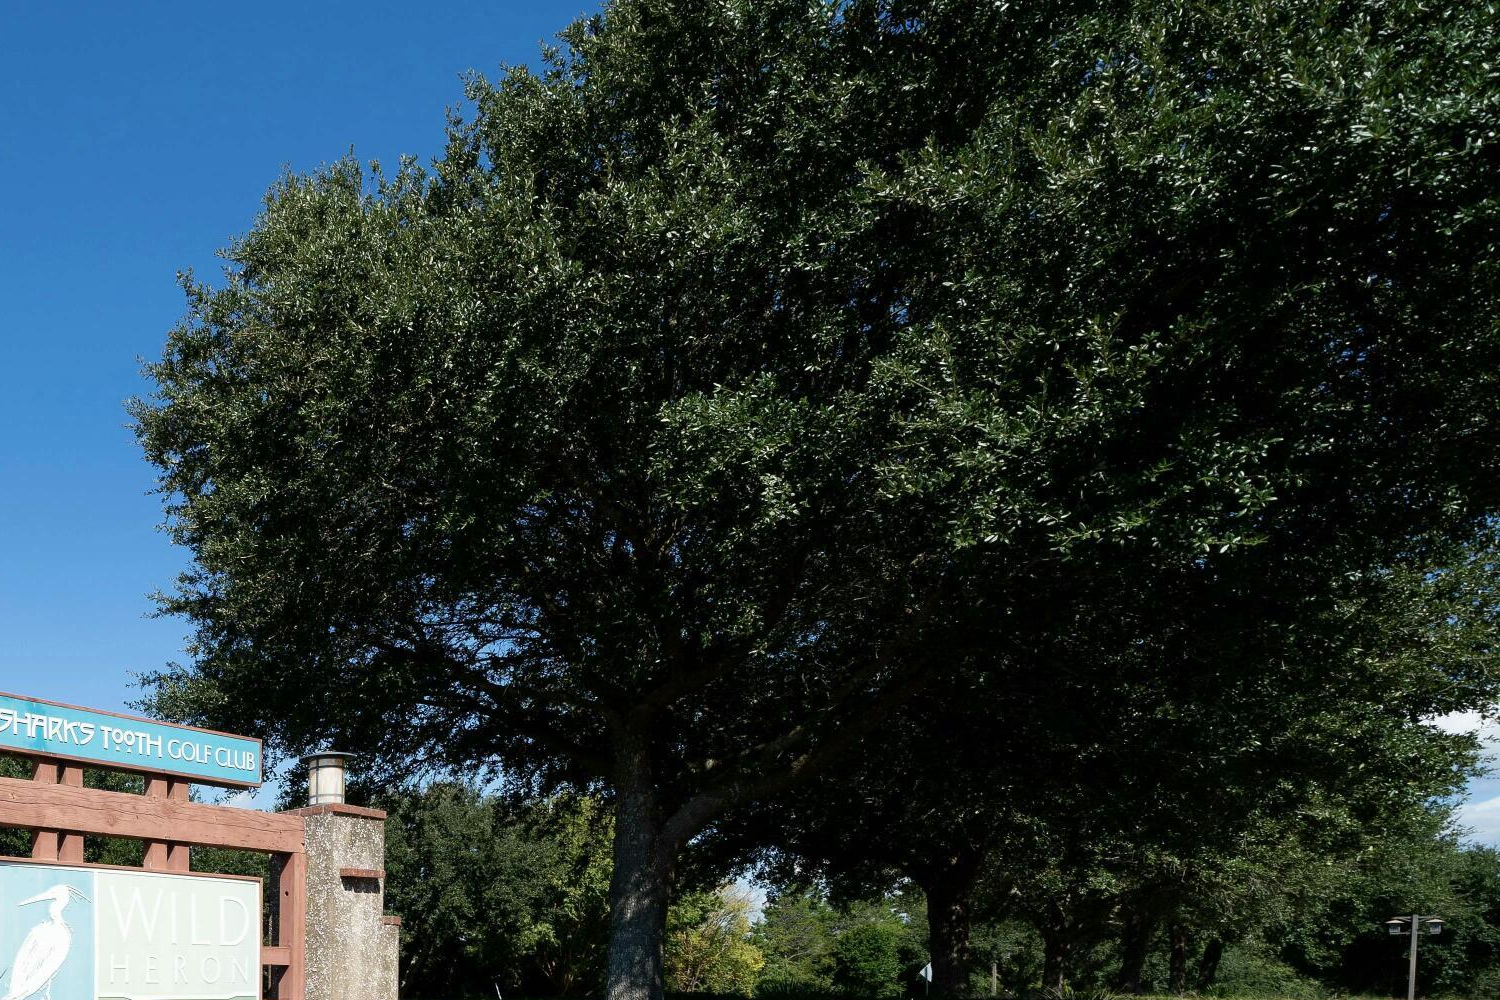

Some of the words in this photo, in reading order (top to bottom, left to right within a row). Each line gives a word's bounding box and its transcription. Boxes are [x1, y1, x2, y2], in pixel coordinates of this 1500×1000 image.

[100, 725, 162, 758] TOOTH
[167, 739, 212, 764] GOLF
[215, 747, 255, 771] CLUB
[109, 886, 250, 946] WILD
[110, 953, 248, 984] HERON
